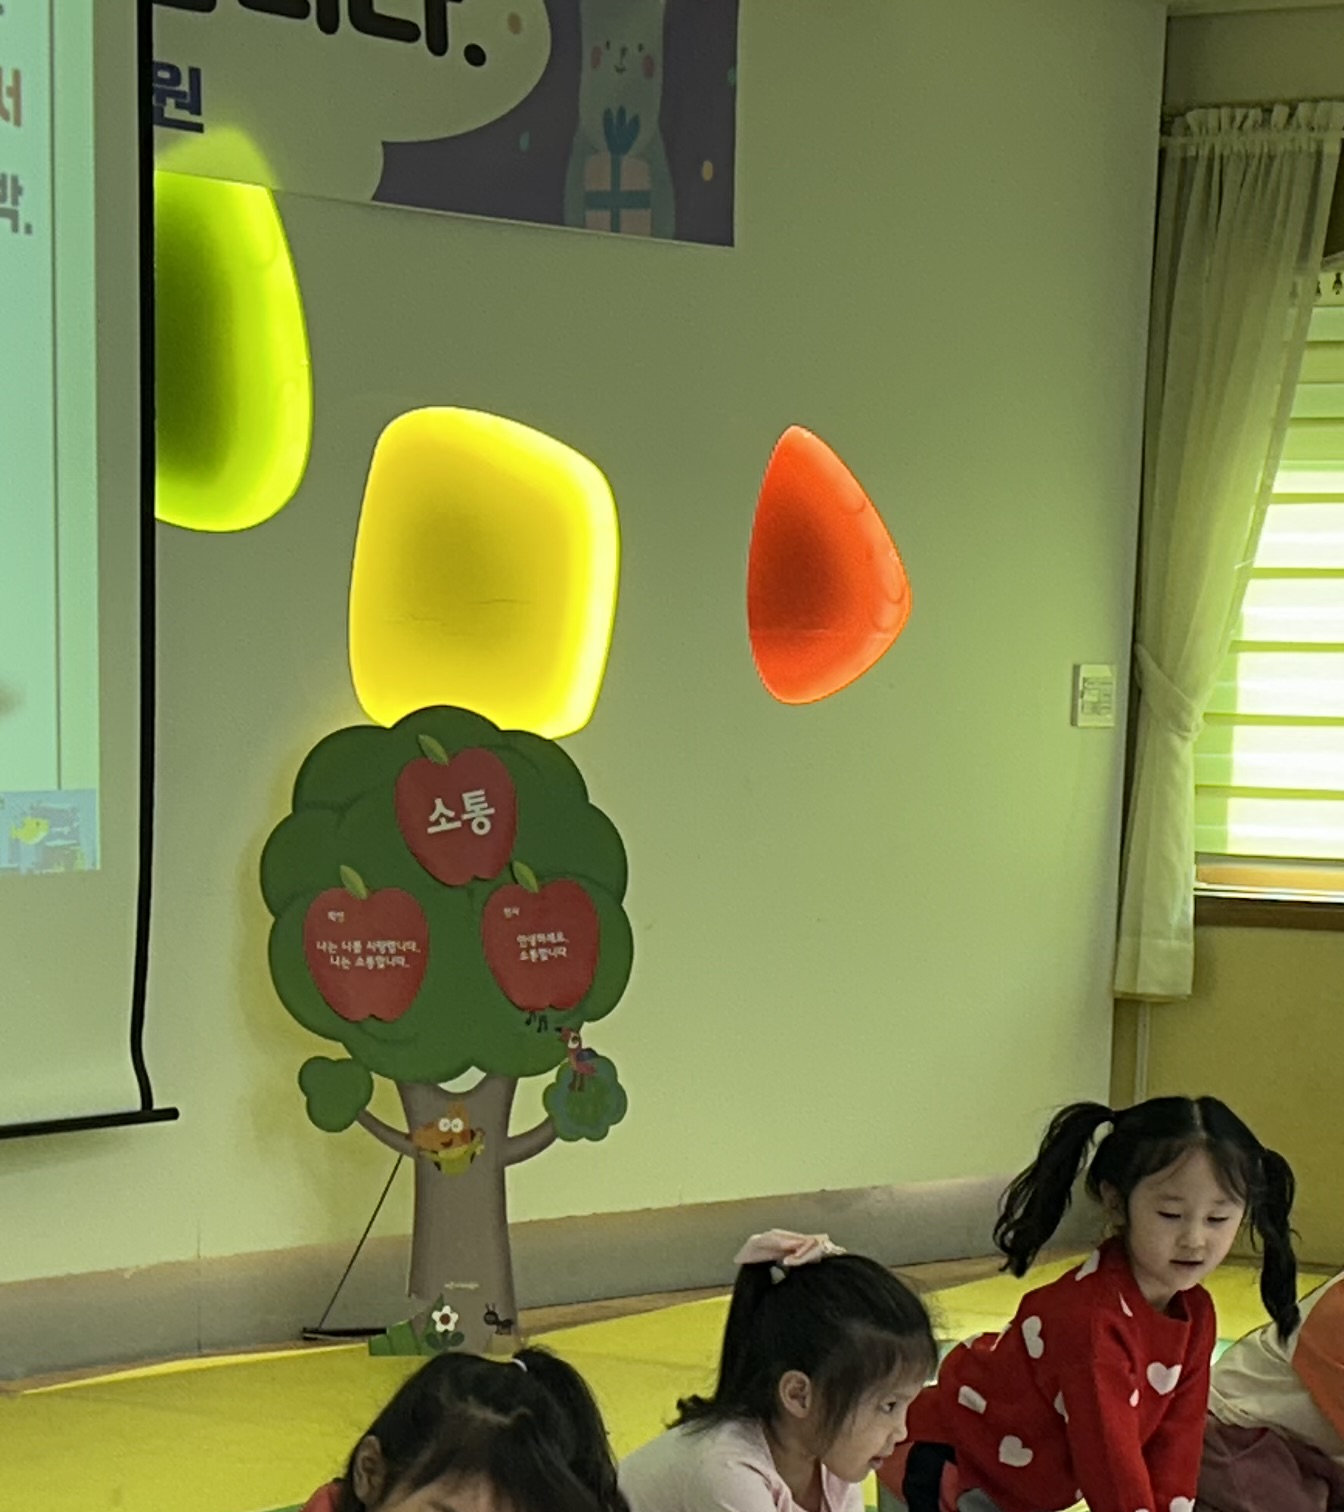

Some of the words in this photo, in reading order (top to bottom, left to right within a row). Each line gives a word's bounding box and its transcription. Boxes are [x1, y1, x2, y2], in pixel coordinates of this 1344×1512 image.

[426, 788, 496, 836] 소통
[316, 940, 338, 954] 나는
[330, 954, 352, 970] 나는
